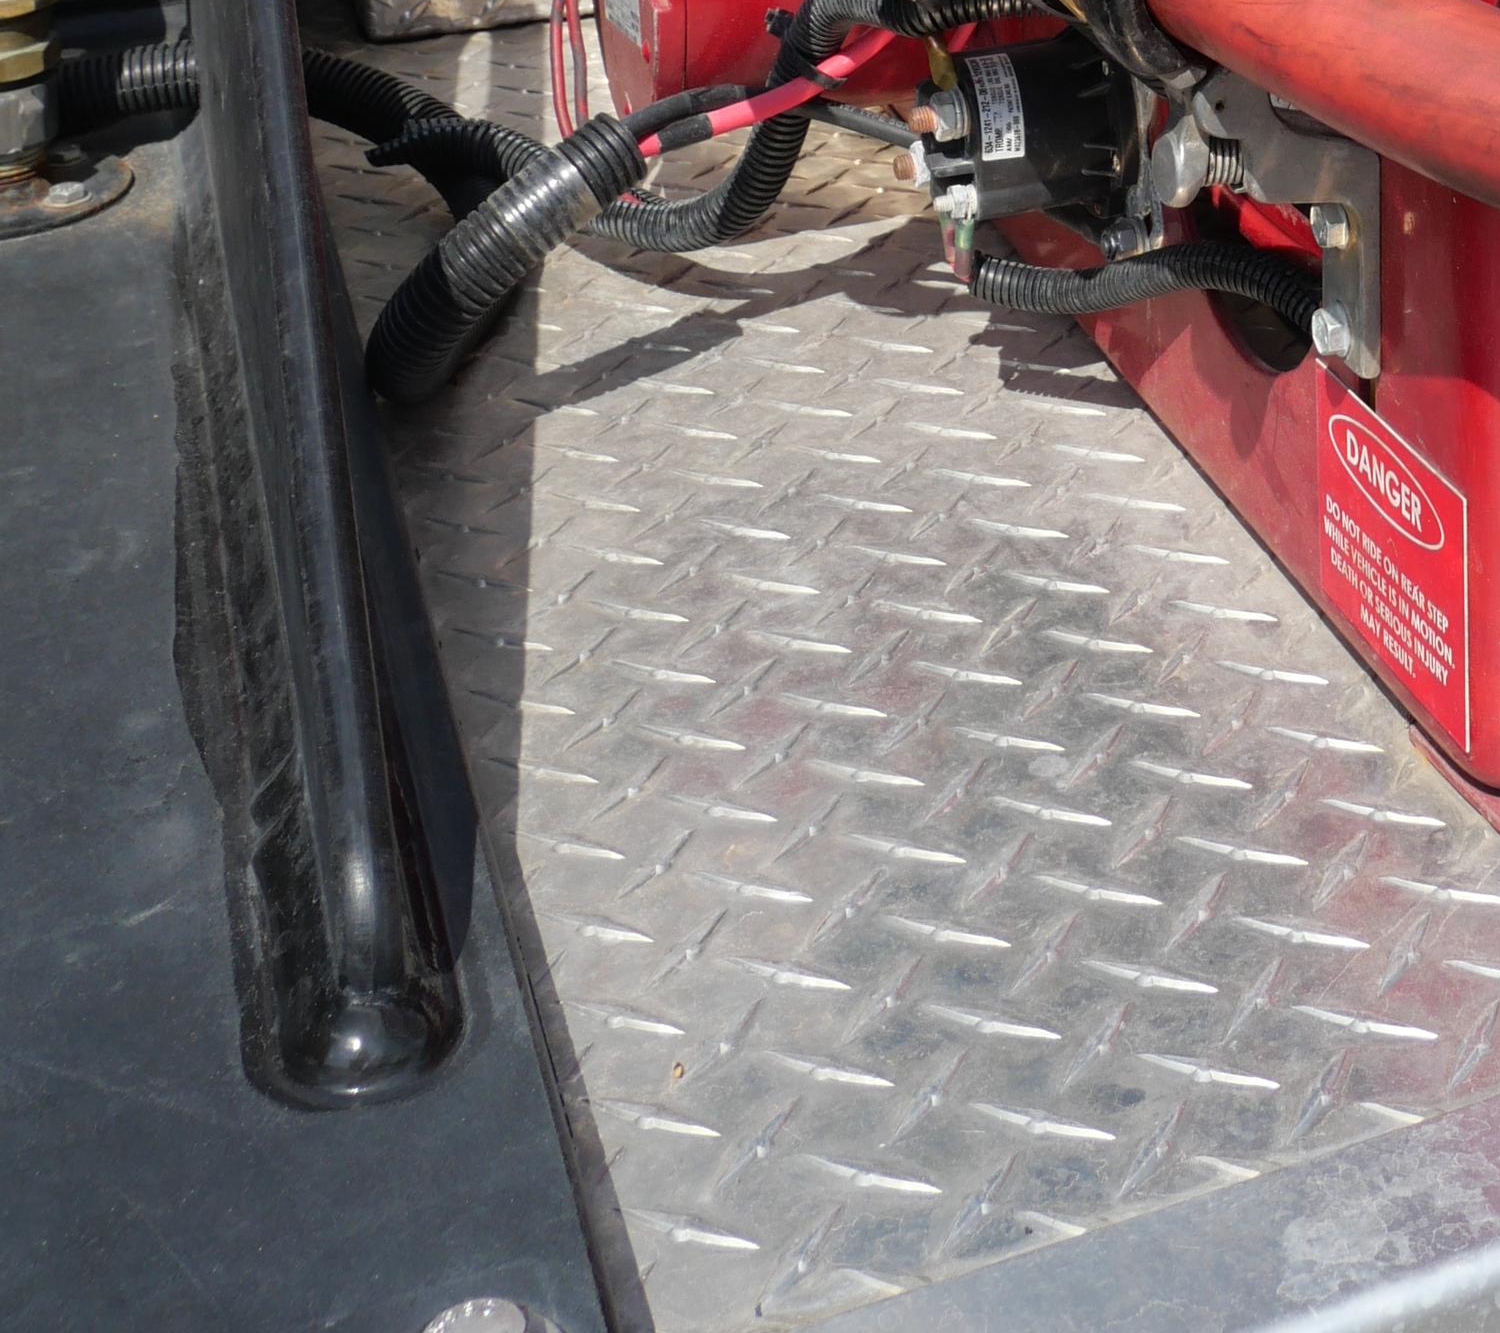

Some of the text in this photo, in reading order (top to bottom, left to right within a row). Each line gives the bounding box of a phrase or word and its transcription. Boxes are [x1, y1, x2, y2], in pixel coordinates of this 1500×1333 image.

[1346, 428, 1423, 533] DANGER
[1323, 515, 1456, 670] WHILE VEHICLE IS IN MOTION.
[1326, 494, 1449, 634] DO NOT RIDE ON REAR STEP
[1331, 546, 1449, 687] DEATH OR SERIOUS INJURY
[1360, 603, 1416, 679] MAY RESULT.
